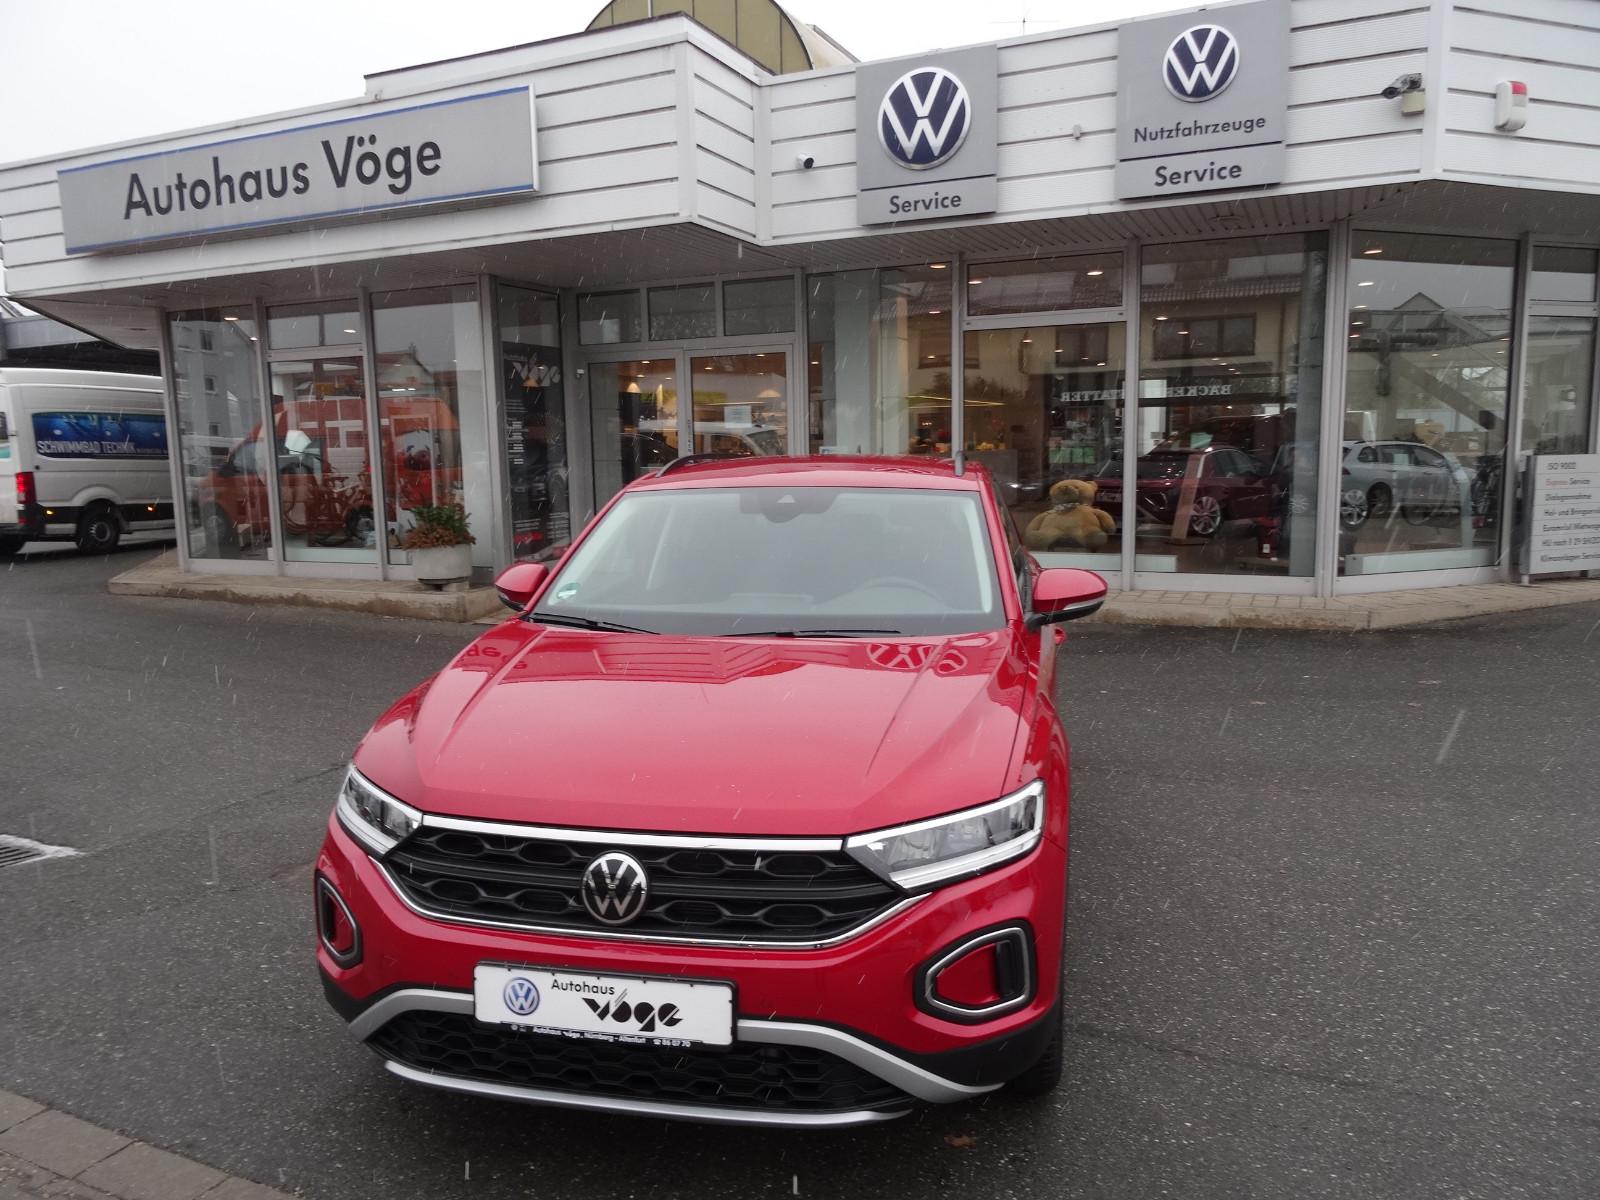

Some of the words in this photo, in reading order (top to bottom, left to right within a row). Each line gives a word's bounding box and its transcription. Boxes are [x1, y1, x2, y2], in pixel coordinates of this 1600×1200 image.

[1133, 113, 1266, 144] Nutzfahrzeuge
[123, 157, 310, 220] Autohaus
[321, 133, 443, 194] Vöge
[1154, 160, 1243, 187] Service
[889, 190, 962, 215] Service
[552, 979, 615, 995] Autohaus
